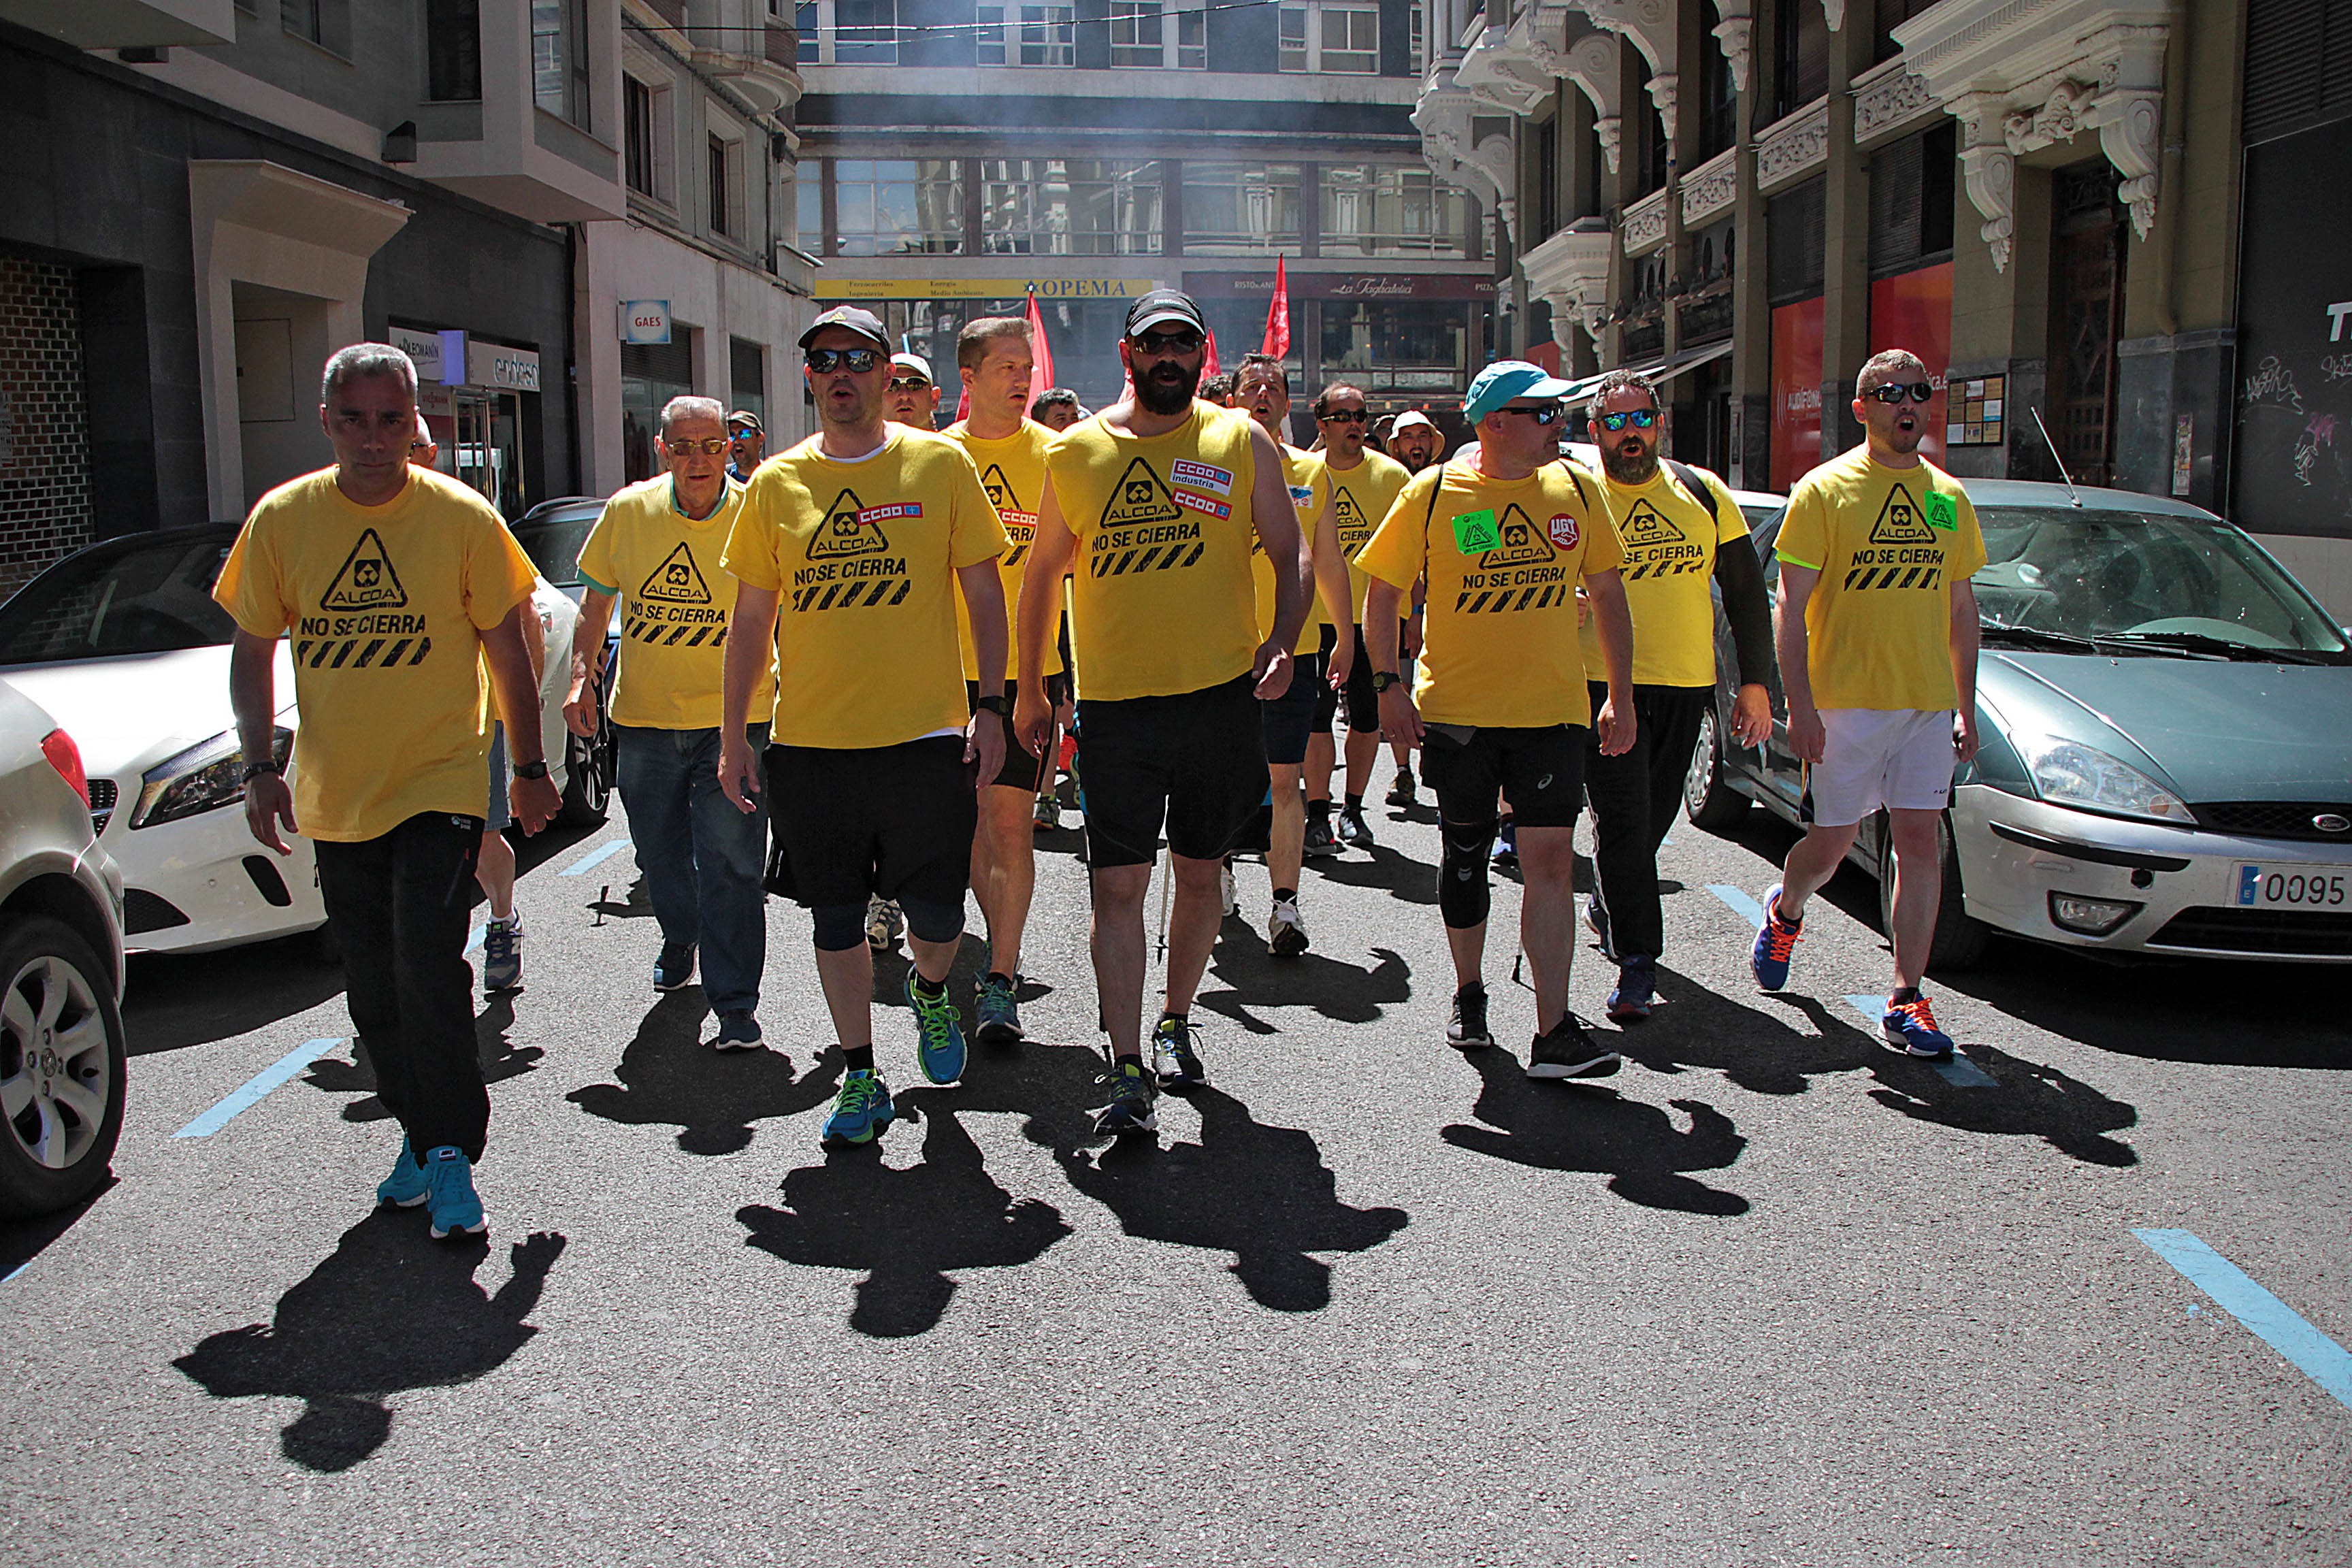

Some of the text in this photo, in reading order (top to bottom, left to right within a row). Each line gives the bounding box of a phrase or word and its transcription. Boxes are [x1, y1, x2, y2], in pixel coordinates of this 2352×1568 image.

[1042, 280, 1126, 296] OPEMA
[1235, 280, 1275, 289] RISTORANT
[635, 316, 661, 327] GAES
[493, 354, 538, 387] endesa
[1177, 463, 1214, 478] CCOO
[1173, 474, 1214, 489] industria
[1175, 492, 1216, 513] CCOO
[860, 506, 902, 523] CCOO
[1002, 512, 1037, 524] CCOO
[1109, 504, 1172, 521] ALCOA
[1552, 519, 1575, 534] UGT
[1878, 529, 1928, 538] ALCOA
[815, 536, 878, 553] ALCOA
[1092, 522, 1200, 552] NO SE CIERRA
[1488, 547, 1546, 563] ALCOA
[1623, 544, 1703, 564] SE CIERRA
[1851, 550, 1875, 566] NO
[1878, 549, 1895, 564] SE
[794, 558, 906, 586] NO SE CIERRA
[1463, 574, 1485, 589] NO
[1490, 572, 1511, 587] SE
[332, 589, 397, 604] ALCOA
[647, 585, 702, 598] ALCOA
[631, 600, 725, 623] NO SE CIERRA
[301, 615, 425, 636] NO SE CIERRA
[2266, 873, 2344, 905] 0095
